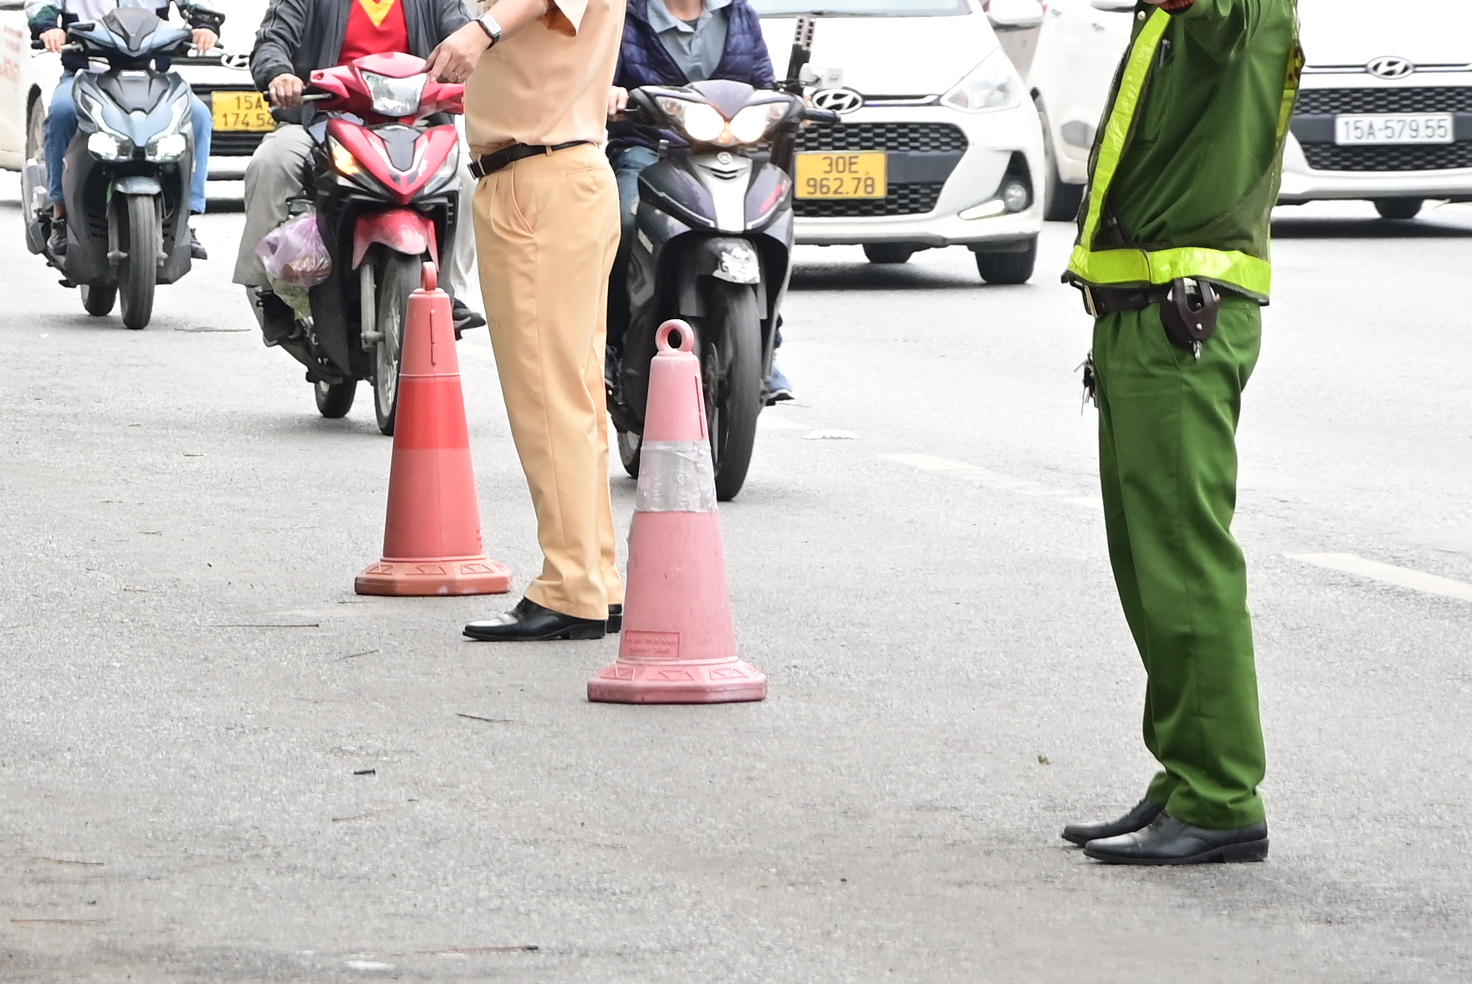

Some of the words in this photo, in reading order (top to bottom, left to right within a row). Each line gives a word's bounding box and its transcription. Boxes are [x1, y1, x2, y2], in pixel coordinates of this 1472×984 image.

[234, 95, 264, 111] 15A
[1343, 118, 1448, 141] 15A-579.55
[822, 155, 860, 175] 30E
[805, 177, 876, 196] 962.78
